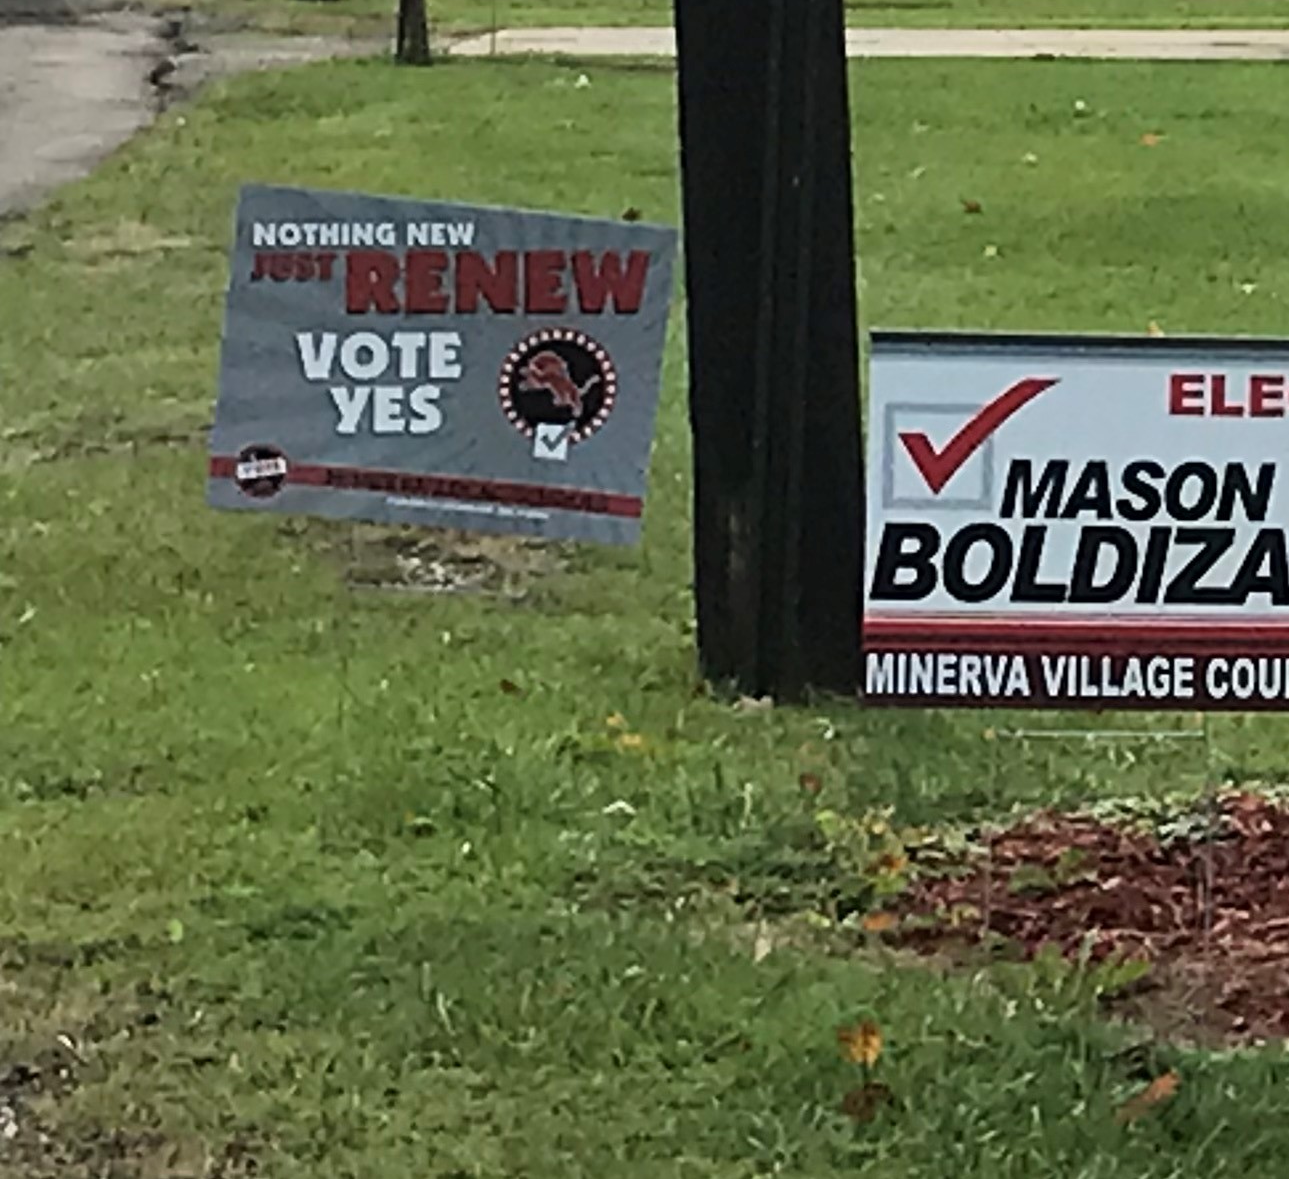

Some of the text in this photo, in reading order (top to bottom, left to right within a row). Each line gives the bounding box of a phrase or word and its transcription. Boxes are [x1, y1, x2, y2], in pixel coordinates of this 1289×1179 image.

[253, 221, 476, 247] NOTHING NEW
[249, 249, 651, 316] JUST RENEW
[296, 331, 462, 381] VOTE
[330, 385, 445, 435] YES
[1000, 458, 1277, 523] MASON
[865, 652, 1031, 698] MINERVA
[1042, 654, 1195, 699] VILLAGE
